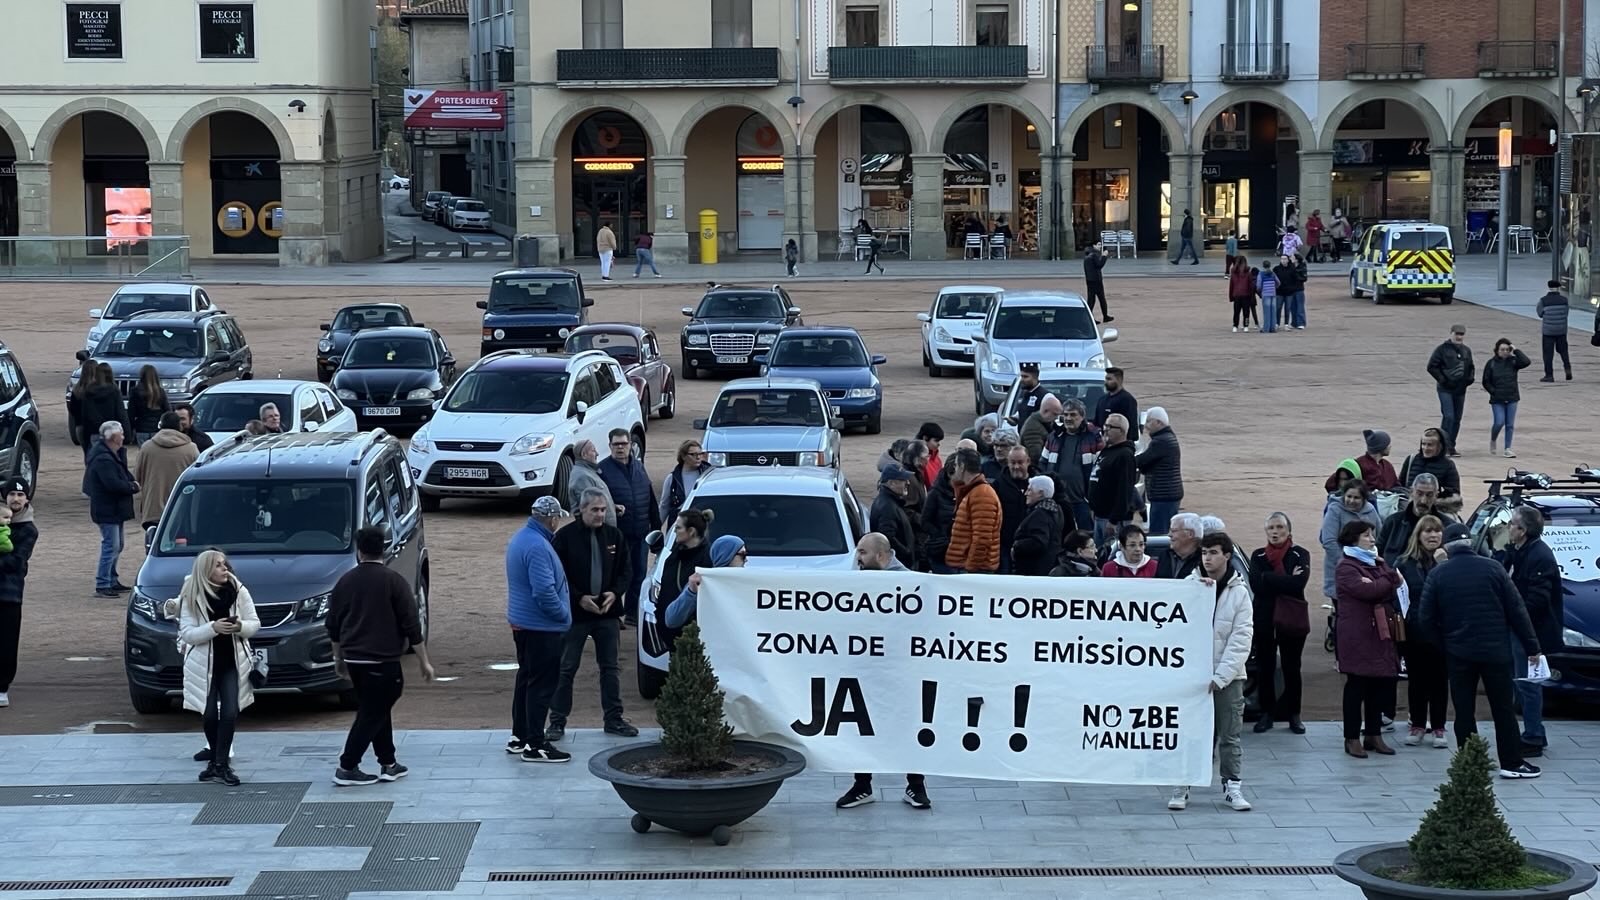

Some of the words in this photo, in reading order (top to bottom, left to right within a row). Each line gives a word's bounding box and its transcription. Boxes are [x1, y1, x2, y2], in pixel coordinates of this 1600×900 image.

[79, 10, 109, 19] PECCI
[212, 10, 242, 19] PECCI
[465, 97, 499, 105] OBERTES
[367, 407, 385, 415] 9670
[449, 468, 469, 477] 2955
[471, 469, 487, 477] HGR
[938, 594, 974, 616] DE
[756, 632, 839, 655] ZONA
[848, 635, 885, 657] DE
[791, 678, 875, 737] JA
[1083, 704, 1122, 729] NO
[1082, 731, 1178, 750] MANLLEU
